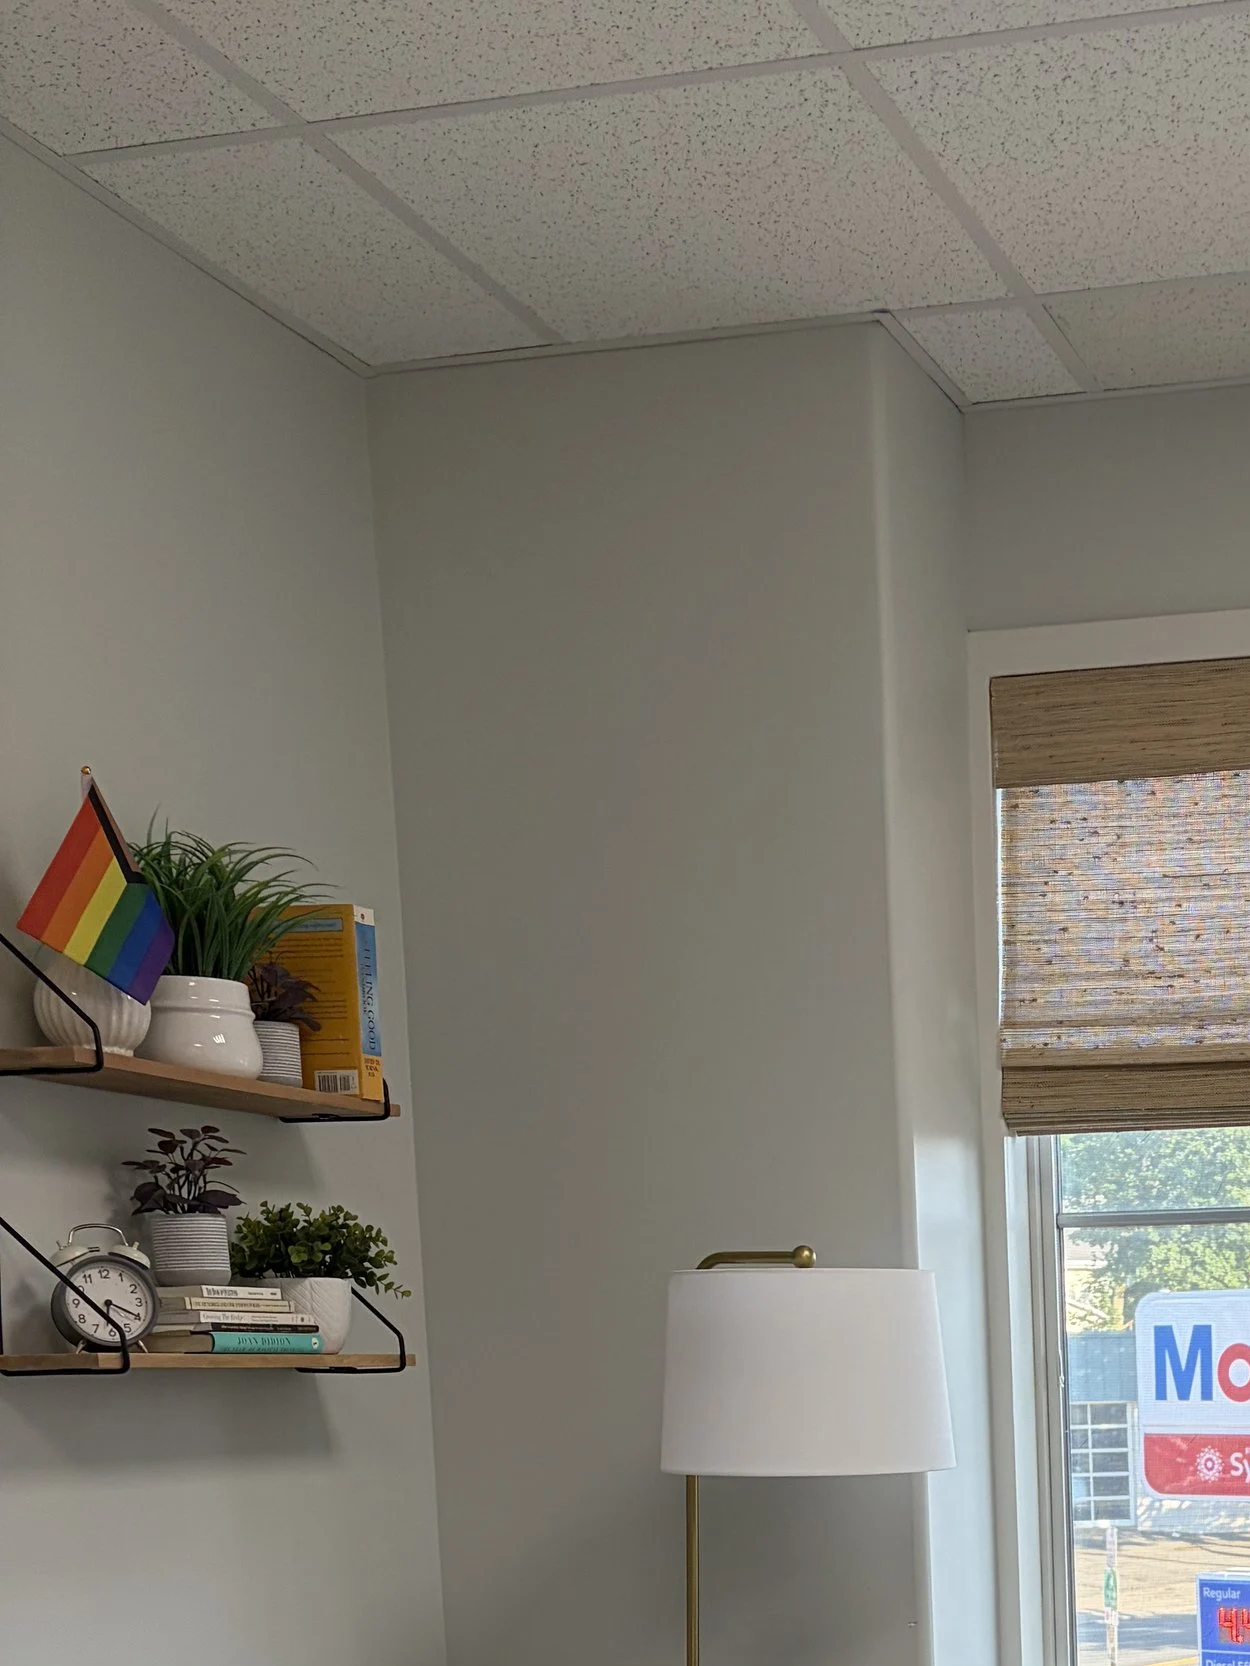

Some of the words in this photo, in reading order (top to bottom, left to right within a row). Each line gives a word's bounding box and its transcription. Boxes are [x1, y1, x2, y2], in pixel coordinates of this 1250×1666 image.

[367, 1010, 377, 1050] GOOD
[82, 1274, 92, 1284] 11
[97, 1269, 110, 1279] 12
[118, 1272, 124, 1282] 1
[129, 1284, 138, 1294] 2
[72, 1298, 80, 1308] 9
[135, 1297, 143, 1307] 3
[78, 1314, 86, 1324] 8
[92, 1324, 100, 1334] 7
[108, 1328, 117, 1337] 6
[123, 1323, 132, 1333] 5
[1203, 1587, 1241, 1602] Regular
